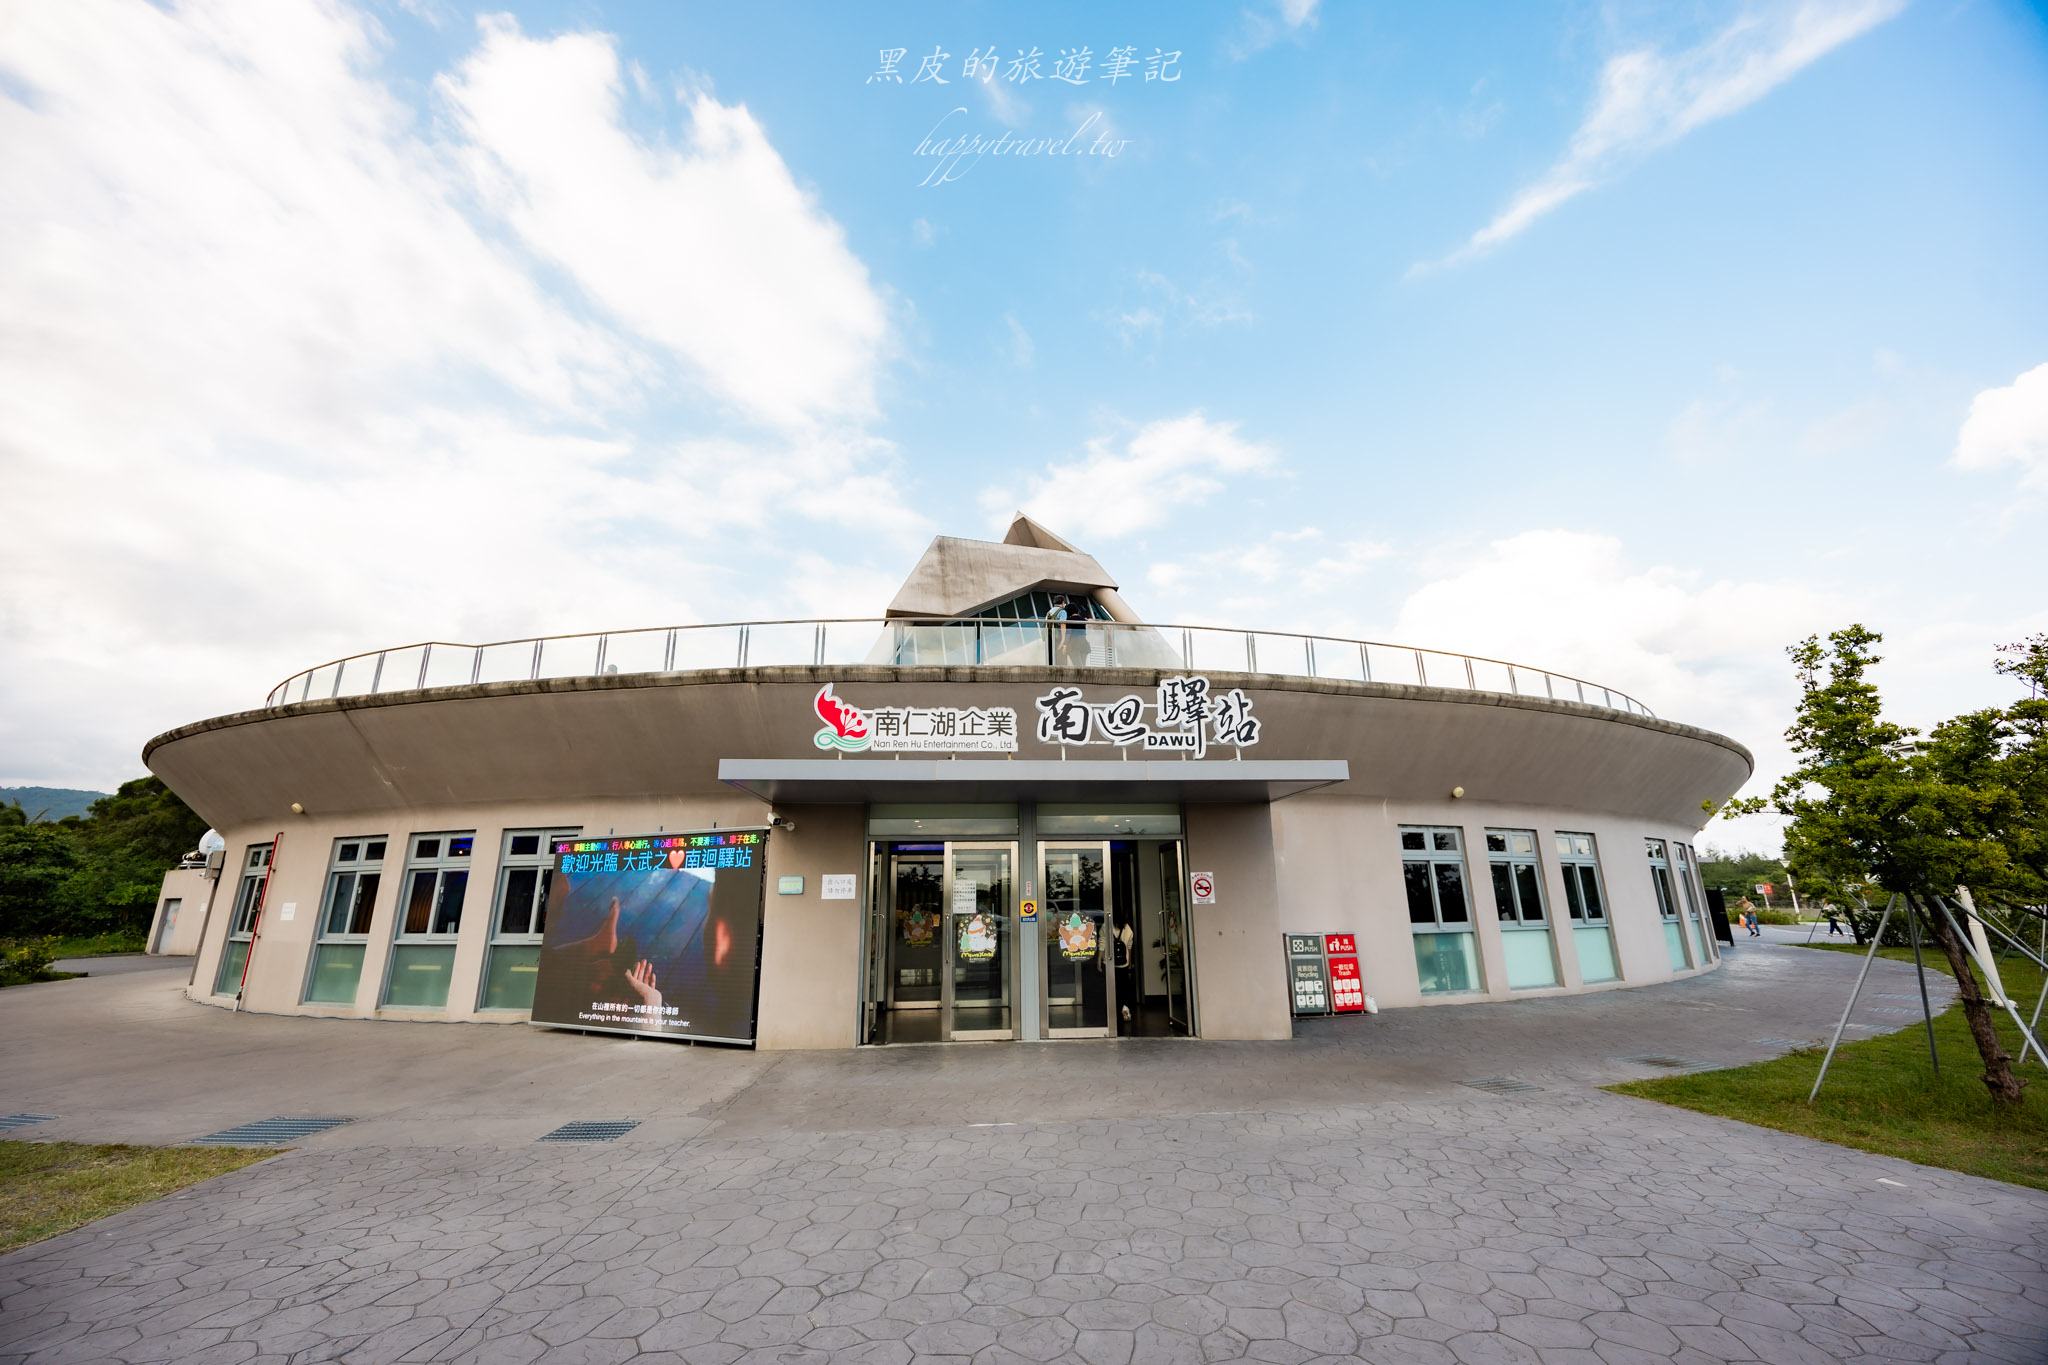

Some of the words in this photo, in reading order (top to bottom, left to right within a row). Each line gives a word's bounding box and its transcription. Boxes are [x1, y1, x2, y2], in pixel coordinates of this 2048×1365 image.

[875, 710, 1013, 737] 南仁湖企業
[873, 739, 891, 749] Nan
[893, 739, 909, 749] Ren
[911, 739, 921, 749] Hu
[923, 739, 979, 749] Entertainment
[1148, 735, 1196, 747] DAWU
[561, 853, 619, 873] 歡迎光臨
[1297, 971, 1319, 979] Recycling
[578, 1012, 605, 1021] Everything
[621, 1016, 649, 1024] mountains
[654, 1018, 668, 1026] your
